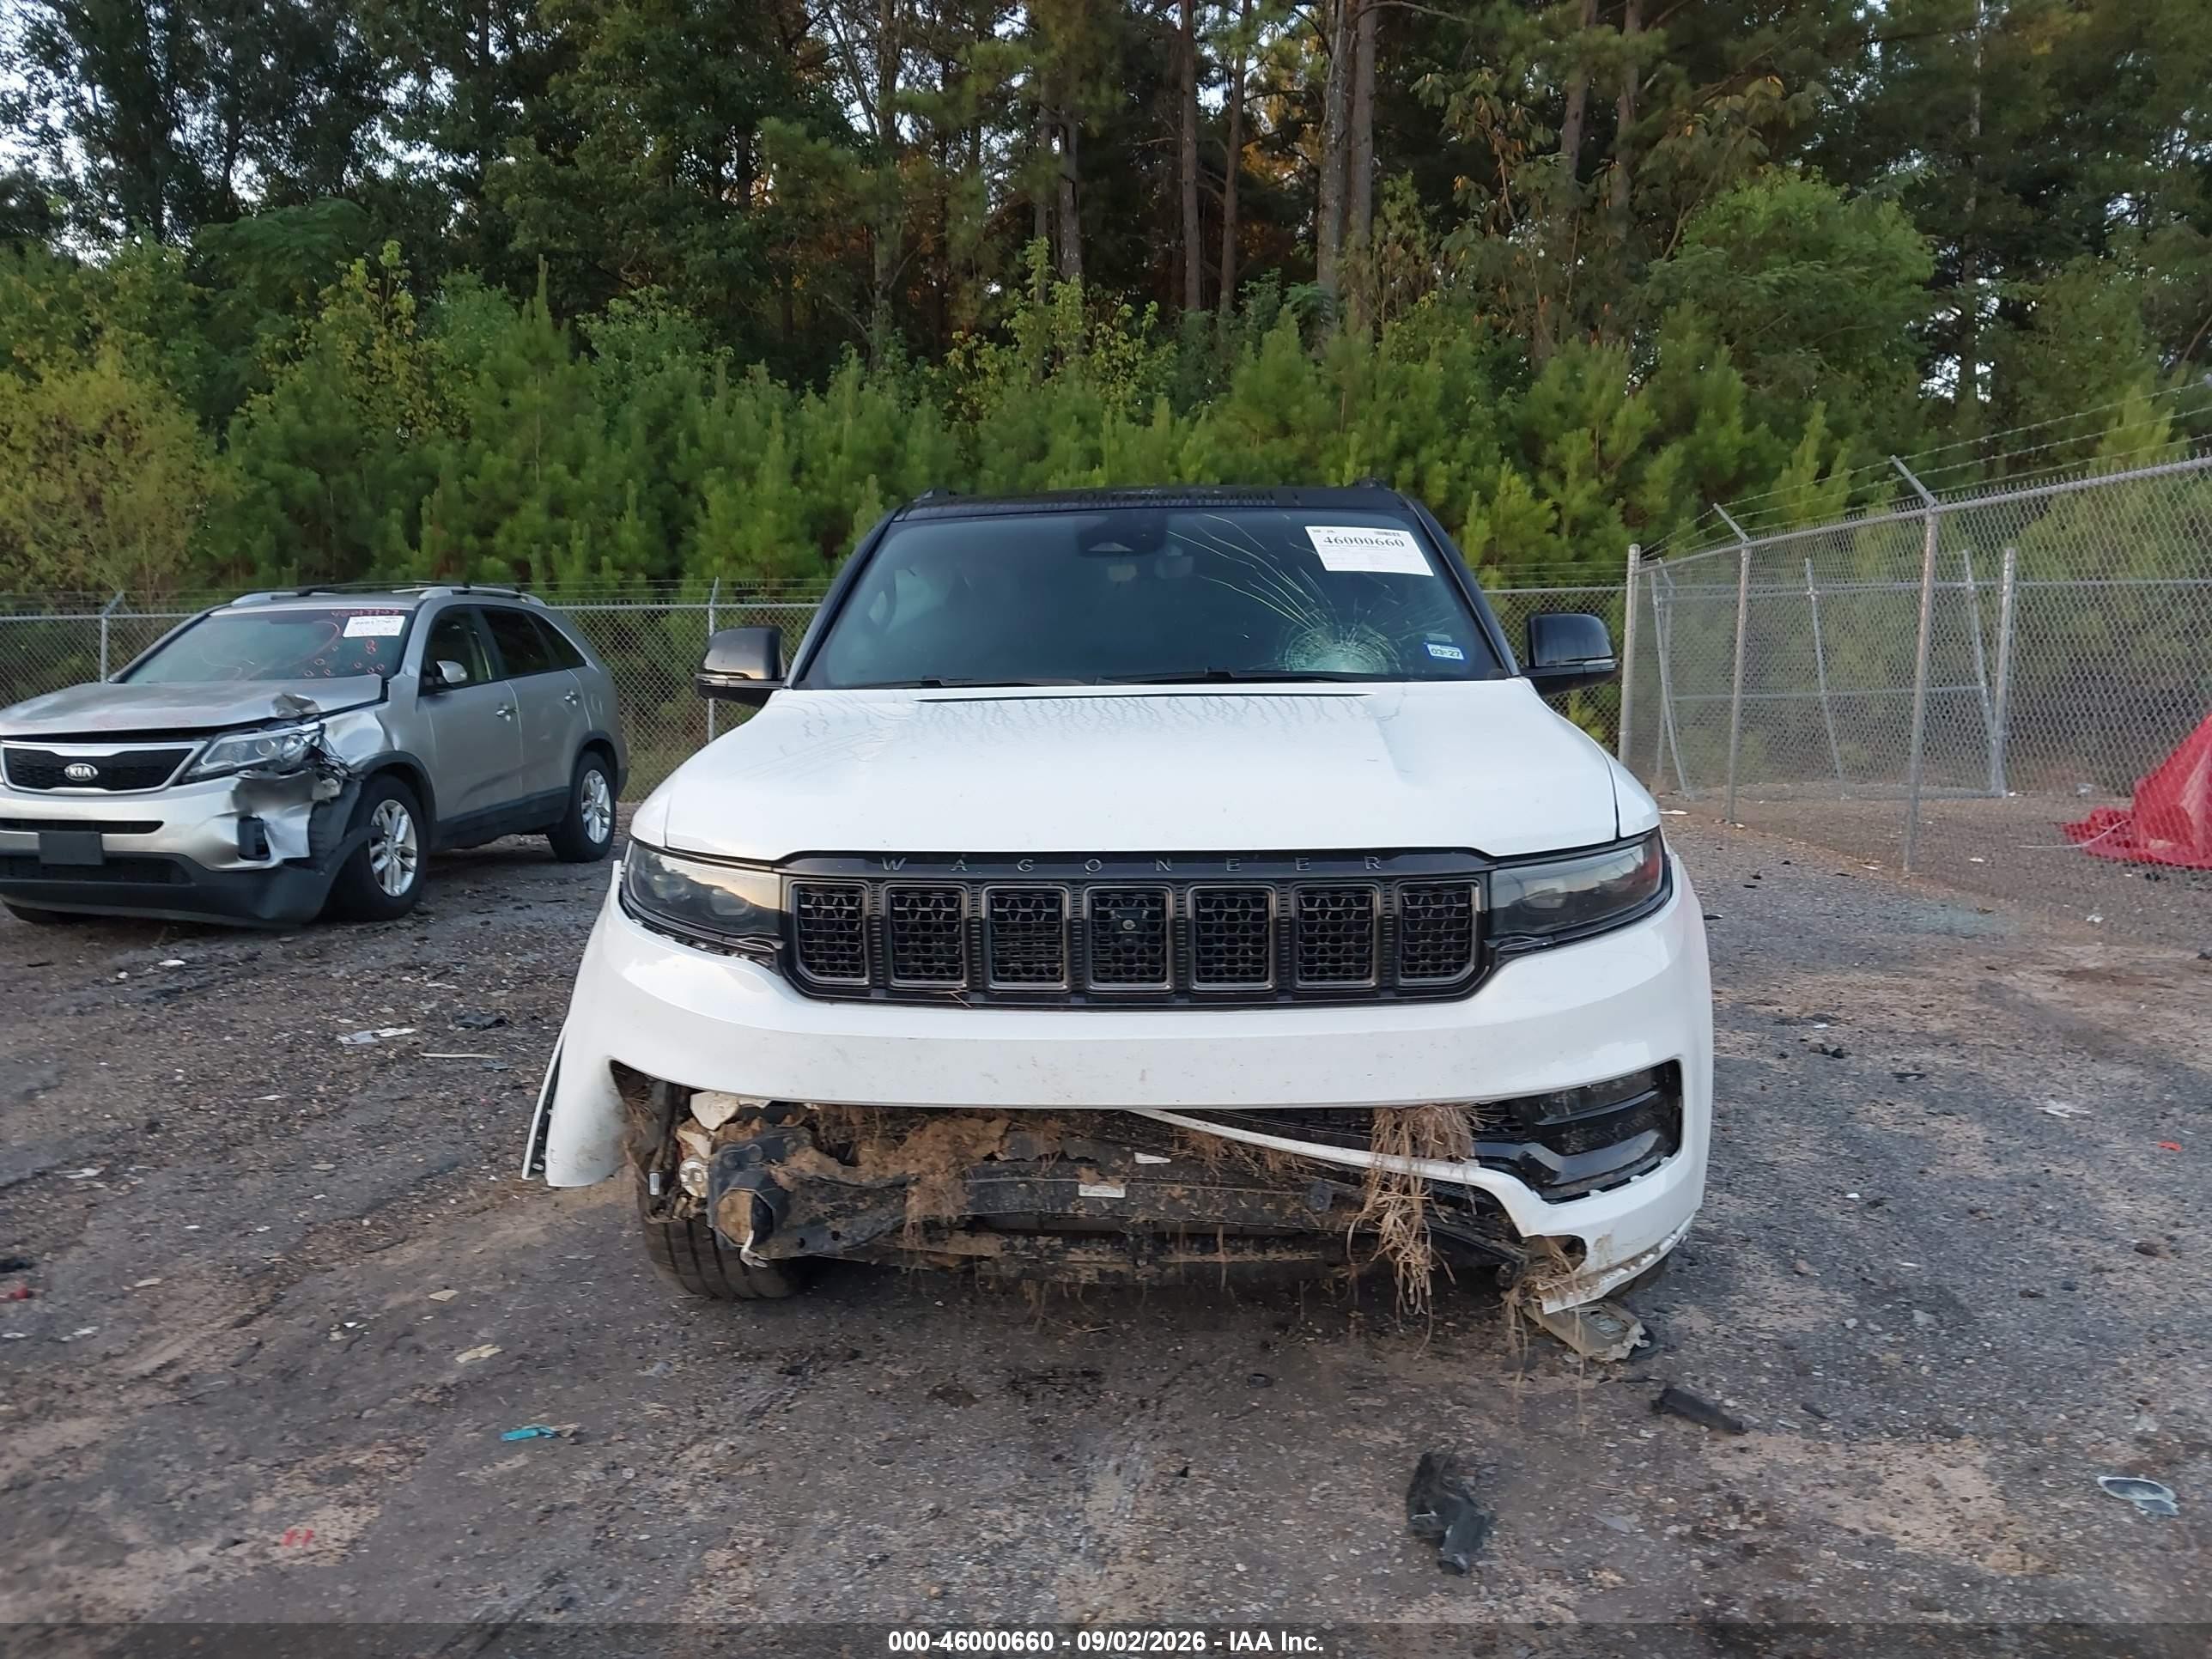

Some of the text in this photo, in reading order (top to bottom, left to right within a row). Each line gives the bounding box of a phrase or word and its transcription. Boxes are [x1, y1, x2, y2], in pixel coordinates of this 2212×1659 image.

[1323, 536, 1406, 548] 46000660
[69, 766, 92, 777] KIA
[881, 856, 1382, 874] WAGONEER
